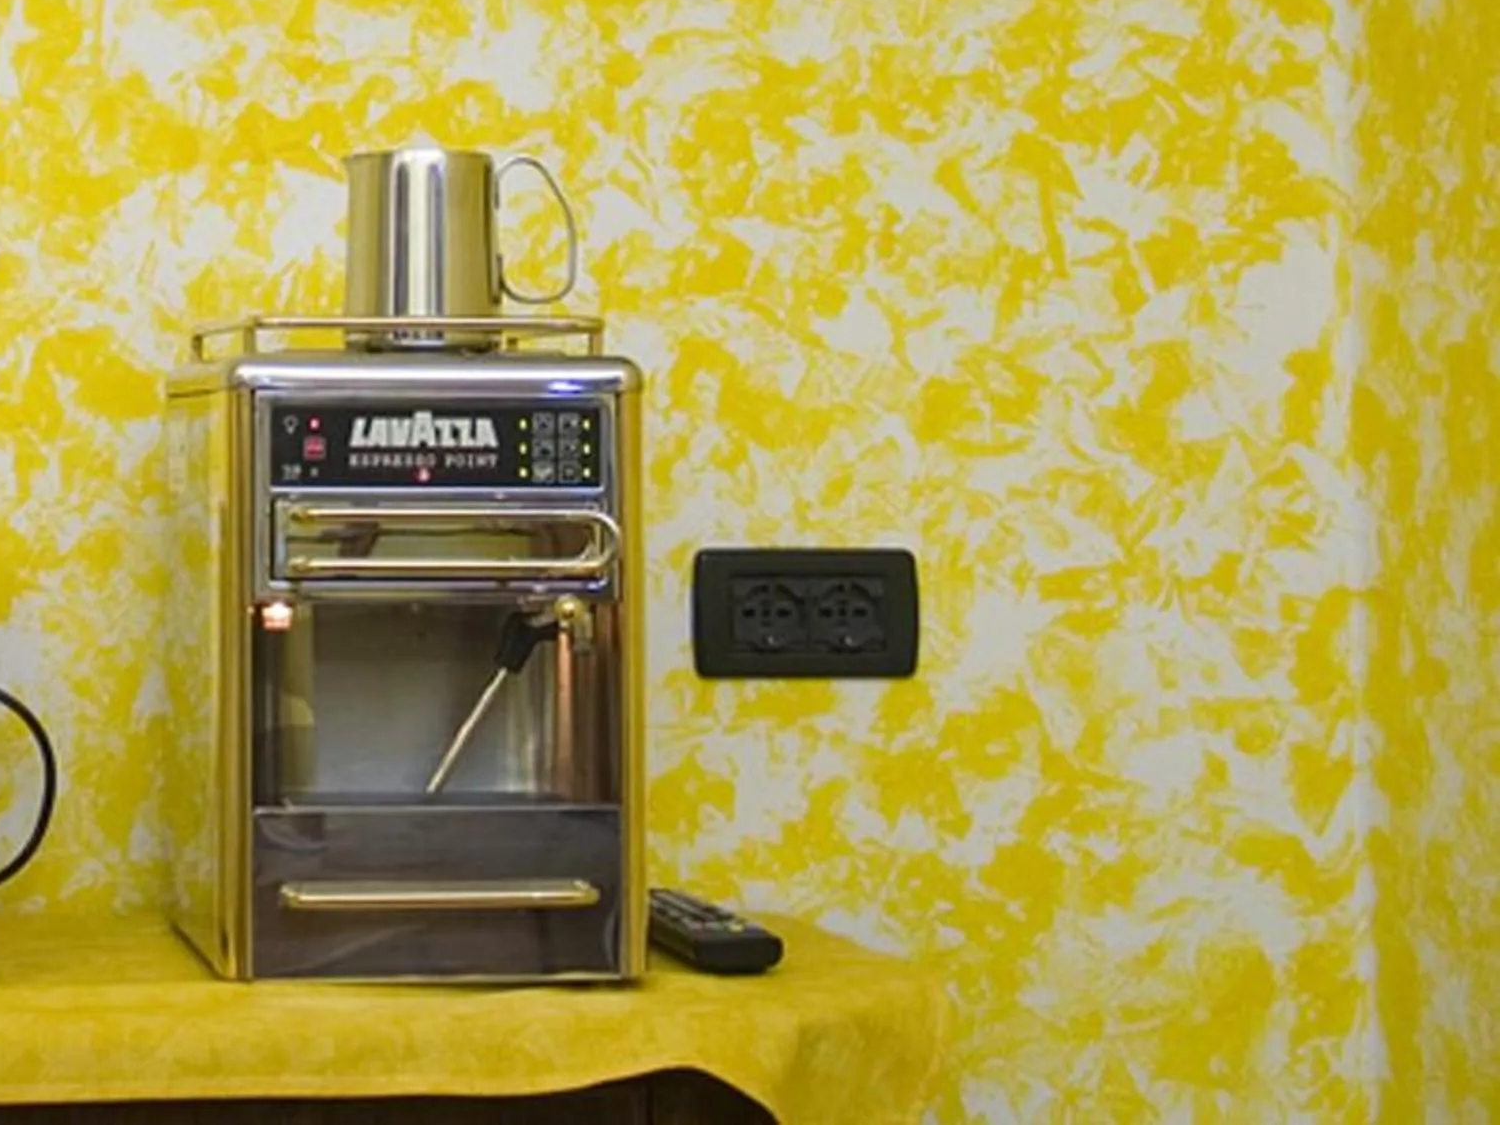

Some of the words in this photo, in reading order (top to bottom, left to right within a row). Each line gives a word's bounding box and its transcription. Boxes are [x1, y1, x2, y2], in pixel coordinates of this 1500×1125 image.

[349, 410, 499, 448] LAVAZZA
[349, 453, 436, 467] ESPRESSO
[445, 453, 498, 467] POINT
